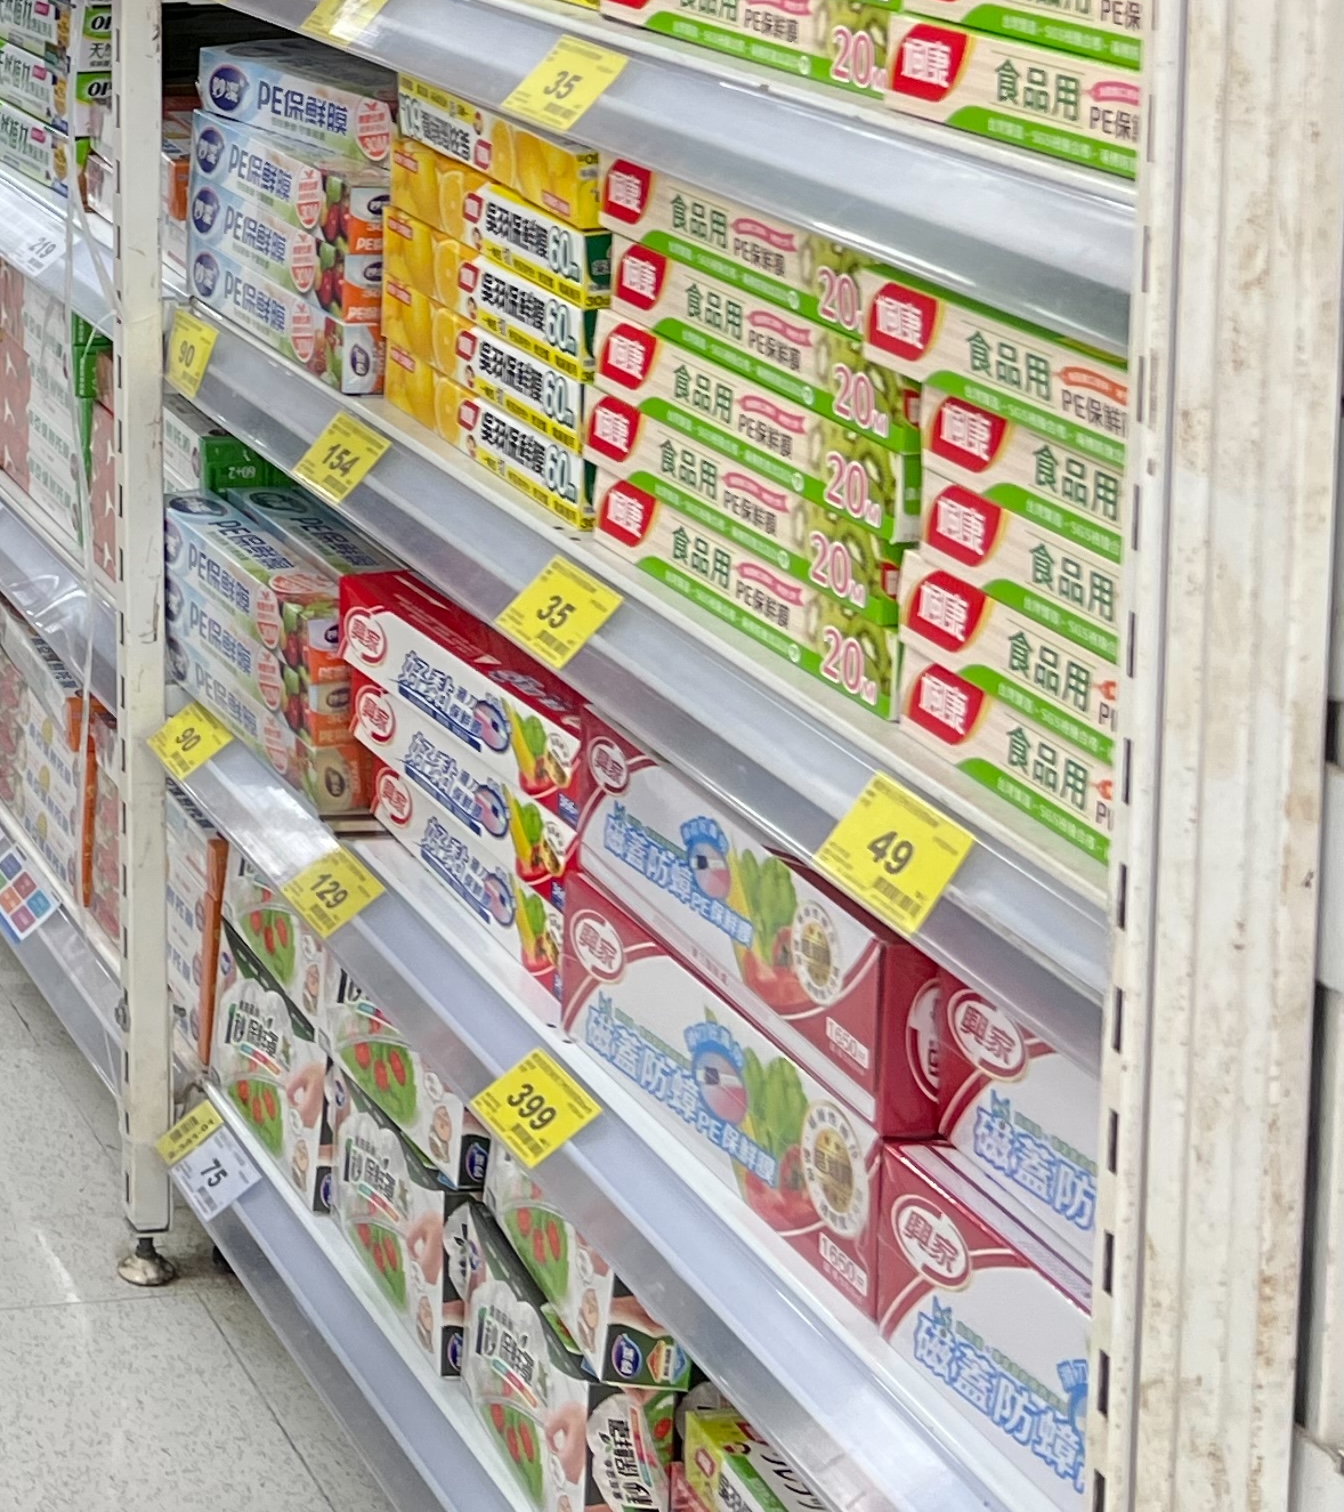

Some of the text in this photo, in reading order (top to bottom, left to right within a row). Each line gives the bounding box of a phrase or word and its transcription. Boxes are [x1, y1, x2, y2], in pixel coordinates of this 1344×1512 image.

[743, 8, 800, 43] PE保鮮膜
[257, 80, 348, 136] PE保鮮膜
[544, 70, 582, 101] 35
[995, 58, 1081, 121] 食品用
[228, 144, 292, 204] PE保鮮膜
[223, 205, 287, 265] PE保鮮膜
[671, 194, 727, 249] 食品用
[734, 238, 785, 277] PE保鮮膜
[224, 270, 286, 332] PE保鮮膜
[686, 283, 743, 341] 食品用
[748, 330, 801, 372] PE保鮮膜
[177, 342, 196, 369] 90
[966, 330, 1127, 438] 食品用 PE保鮮
[321, 443, 362, 478] 154
[739, 414, 793, 460] PE保鮮膜
[1033, 444, 1118, 521] 食品用
[723, 490, 777, 537] PE保鮮膜
[188, 544, 251, 614] PE保鮮膜
[1030, 542, 1113, 623] 食品用
[189, 601, 252, 675] PE保鮮膜
[535, 594, 575, 629] 35
[194, 663, 257, 735] PE保鮮膜
[1008, 630, 1091, 712] 食品用
[174, 727, 202, 753] 90
[1006, 726, 1088, 811] 食品用
[866, 829, 916, 876] 49
[309, 873, 349, 909] 129
[959, 1009, 1015, 1064] 興家
[507, 1084, 557, 1133] 399
[586, 1003, 777, 1186] 磁蓋防蟑 PE保鮮膜
[200, 1157, 228, 1190] 75
[974, 1105, 1096, 1231] 磁蓋防
[904, 1208, 960, 1275] 興家
